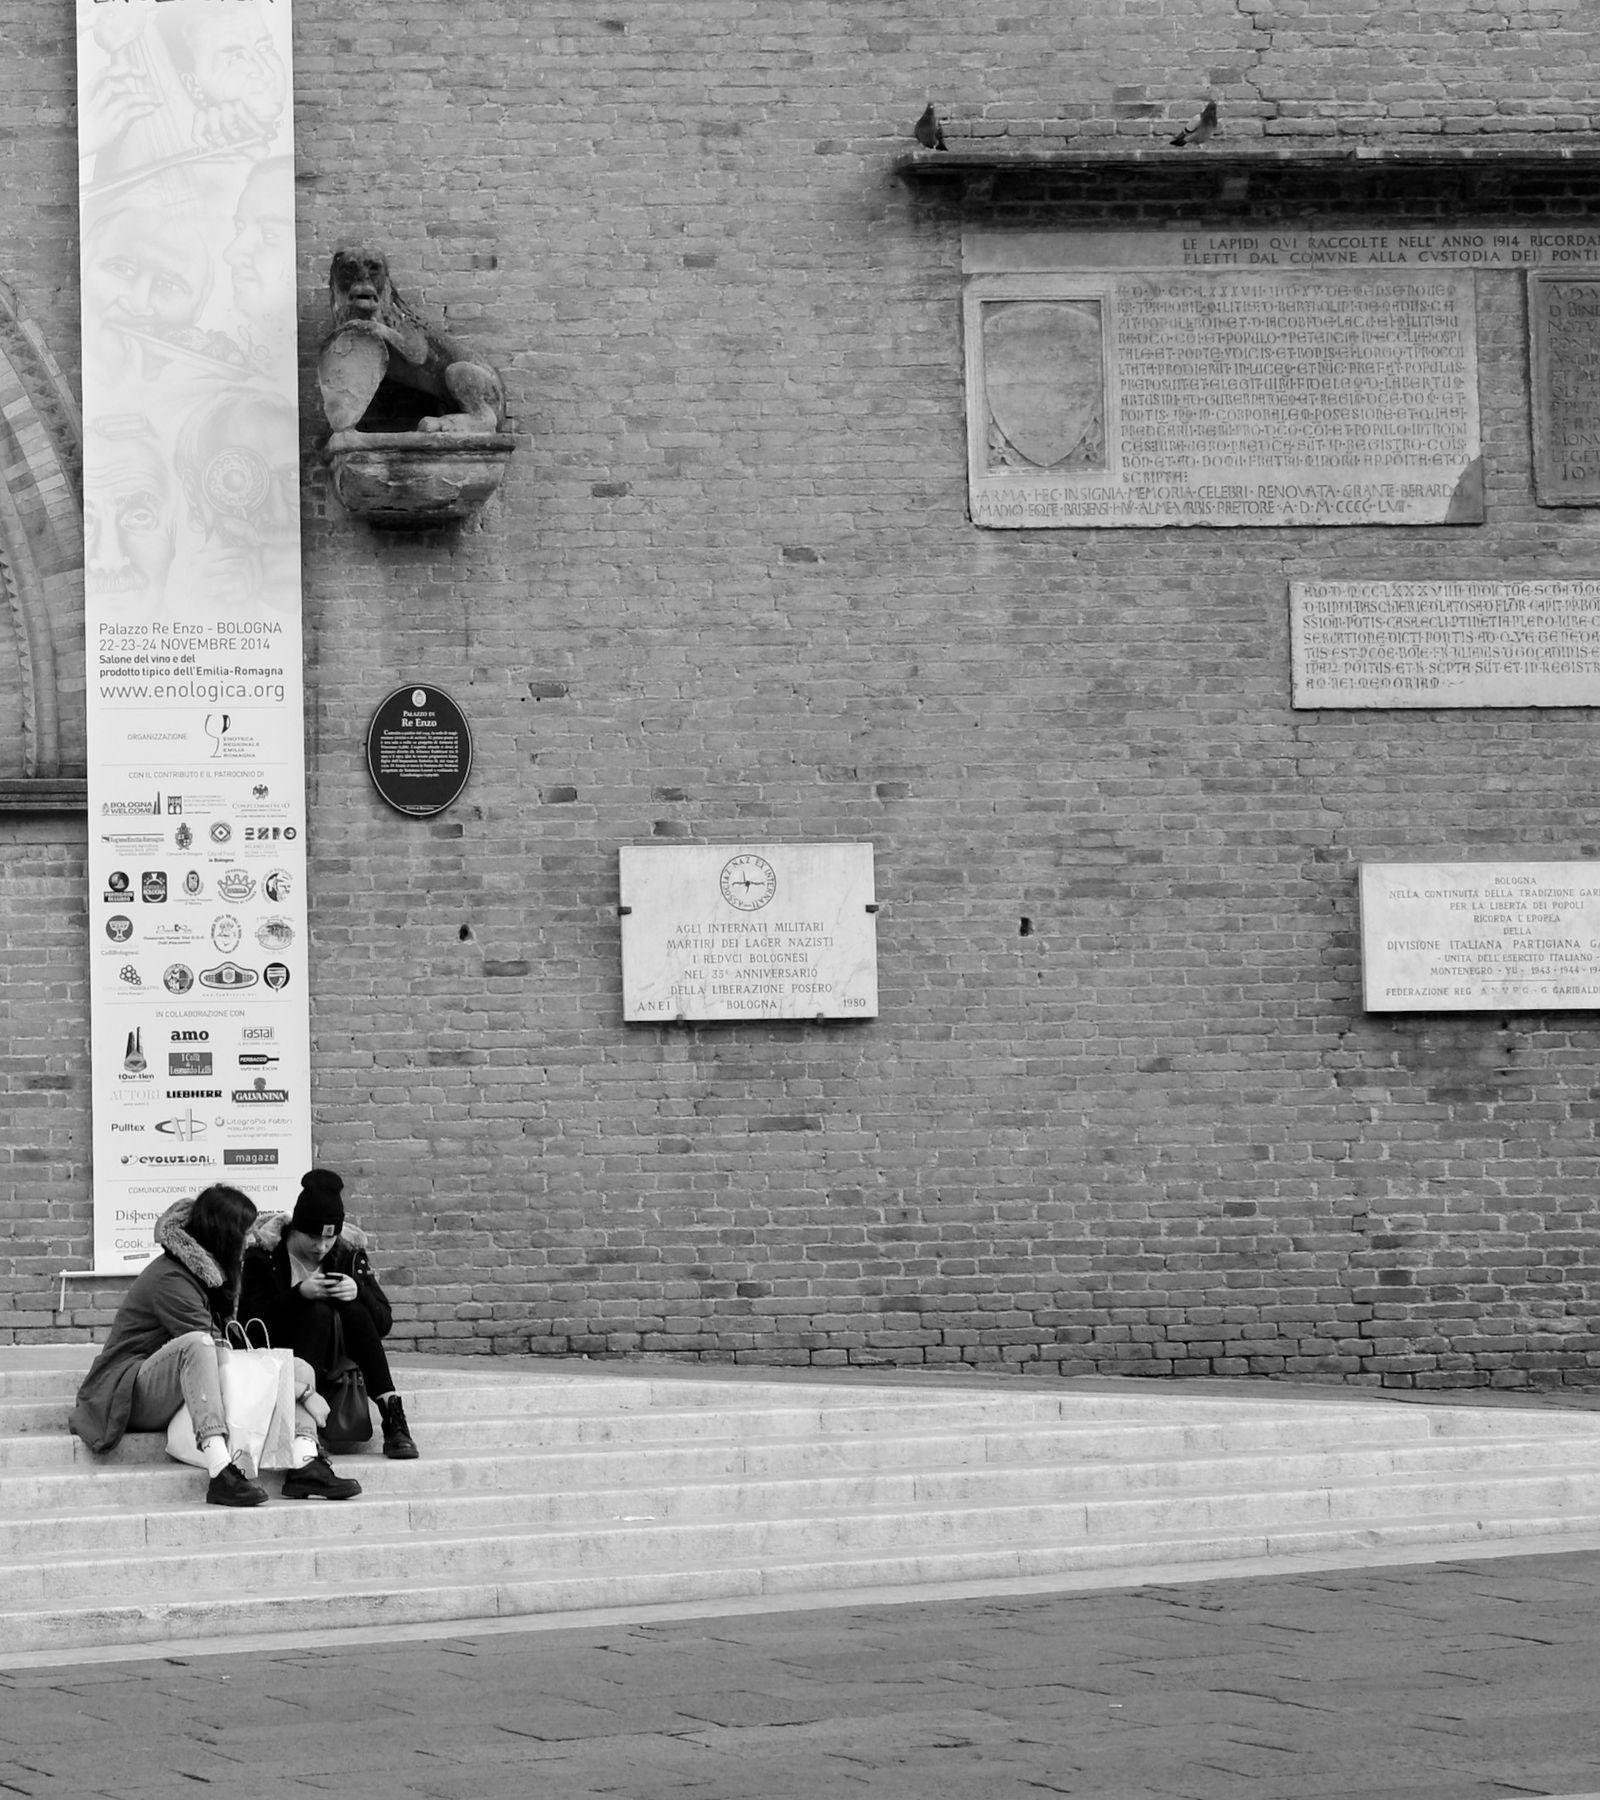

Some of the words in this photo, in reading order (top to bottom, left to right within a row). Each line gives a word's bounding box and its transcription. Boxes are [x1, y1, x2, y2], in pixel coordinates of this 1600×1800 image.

[1182, 238, 1198, 250] LE
[1209, 237, 1259, 250] LAPIDI
[1307, 236, 1388, 249] RACCOLTE
[1441, 235, 1484, 248] ANNO
[1493, 235, 1520, 247] 1914
[1184, 252, 1238, 265] ELETTI
[1249, 252, 1280, 264] DAL
[1289, 251, 1358, 264] COMVNE
[1368, 250, 1407, 263] ALLA
[1418, 249, 1501, 262] CVSTODIA
[1511, 249, 1537, 261] DEI
[1552, 249, 1598, 261] PONTI
[99, 623, 148, 635] Palazzo
[152, 622, 169, 634] Re
[173, 622, 204, 634] Enzo
[217, 621, 282, 634] BOLOGNA
[99, 638, 157, 651] 22-23-24
[160, 637, 237, 650] NOVEMBRE
[240, 637, 271, 650] 2014
[99, 655, 132, 665] Salone
[133, 654, 149, 664] del
[151, 654, 170, 664] vino
[180, 654, 196, 664] del
[100, 667, 140, 679] prodotto
[142, 667, 170, 678] tipico
[173, 666, 283, 677] dell'Emilia-Romagna
[100, 680, 285, 702] www.enologica.org
[401, 718, 414, 727] Re
[415, 718, 437, 727] Enzo
[127, 732, 188, 742] ORGANIZZAZIONE
[153, 771, 199, 779] CONTRIBUTO
[214, 770, 255, 778] PATROCINIO
[1494, 876, 1537, 885] BOLOGNA
[1389, 889, 1420, 899] NELLA
[1485, 889, 1513, 898] DELLA
[1520, 888, 1575, 898] TRADIZIONE
[1450, 902, 1467, 911] PER
[1472, 902, 1485, 911] LA
[1533, 901, 1547, 910] DEI
[1552, 901, 1584, 910] POPOLI
[1473, 914, 1513, 923] RICORDA
[676, 923, 701, 934] AGLI
[708, 922, 767, 934] INTERNATI
[774, 921, 824, 932] MILITARI
[1503, 927, 1532, 936] DELLA
[666, 938, 715, 949] MARTIRI
[721, 938, 739, 949] DEI
[745, 937, 782, 948] LAGER
[788, 936, 834, 947] NAZISTI
[1387, 940, 1441, 951] DIVISIONE
[1450, 940, 1503, 950] ITALIANA
[1513, 939, 1581, 949] PARTIGIANA
[749, 952, 808, 963] BOLOGNESI
[1549, 953, 1593, 963] ITALIANO
[684, 969, 705, 980] NEL
[735, 967, 818, 980] ANNIVERSARIO
[1430, 966, 1493, 977] MONTENEGRO
[1531, 966, 1551, 975] 1943
[1560, 966, 1580, 975] 1944
[671, 985, 705, 996] DELLA
[712, 984, 784, 995] LIBERAZIONE
[791, 983, 833, 994] POSERO
[1386, 987, 1449, 997] FEDERAZIONE
[1454, 987, 1472, 996] REG
[726, 998, 778, 1010] BOLOGNA
[843, 997, 866, 1008] 1980
[164, 1010, 228, 1018] COLLABORAZIONE
[170, 1029, 210, 1041] amo
[166, 1090, 223, 1099] LIEBHERR
[235, 1091, 285, 1102] GALVANINA
[111, 1123, 145, 1132] Pulltex
[236, 1154, 276, 1165] magaze
[128, 1186, 186, 1194] COMUNICAZIONE
